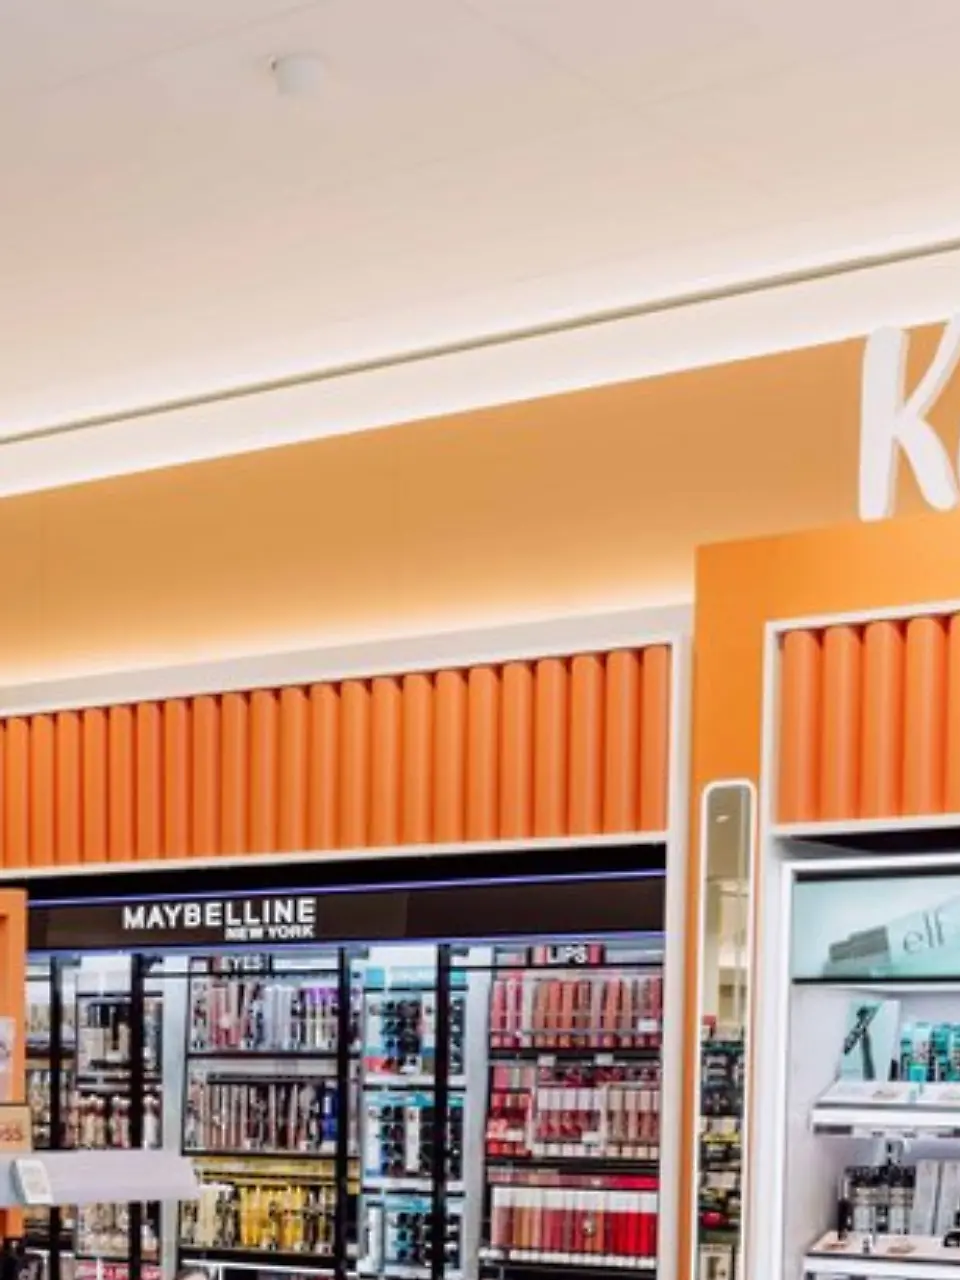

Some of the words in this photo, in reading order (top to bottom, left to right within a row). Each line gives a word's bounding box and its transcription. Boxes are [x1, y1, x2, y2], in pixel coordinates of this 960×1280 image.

[122, 897, 317, 929] MAYBELLINE
[224, 925, 264, 941] NEW
[269, 924, 316, 940] YORK
[549, 946, 588, 964] LIPS
